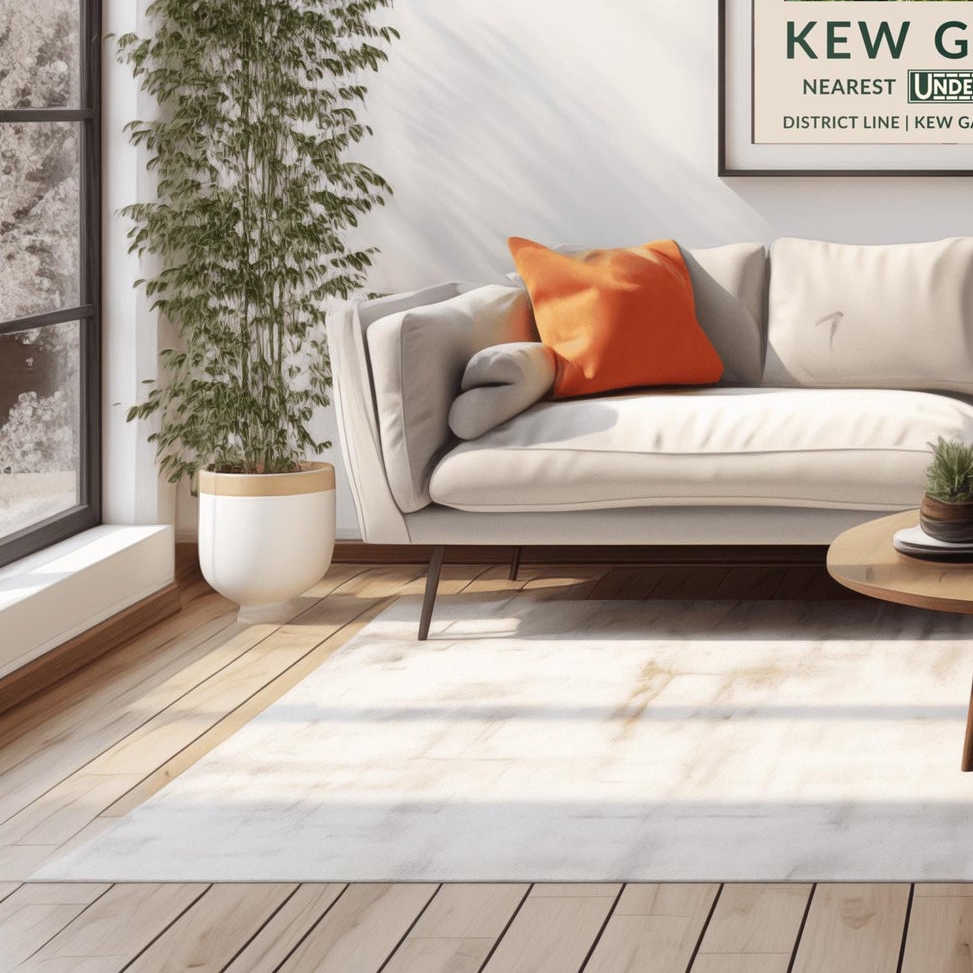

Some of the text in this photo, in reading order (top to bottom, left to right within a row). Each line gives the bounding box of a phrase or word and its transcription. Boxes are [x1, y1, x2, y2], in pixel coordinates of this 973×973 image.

[786, 20, 911, 60] KEW
[803, 78, 897, 95] NEAREST
[783, 115, 859, 130] DISTRICT
[863, 115, 900, 129] LINE
[914, 115, 954, 129] KEW
